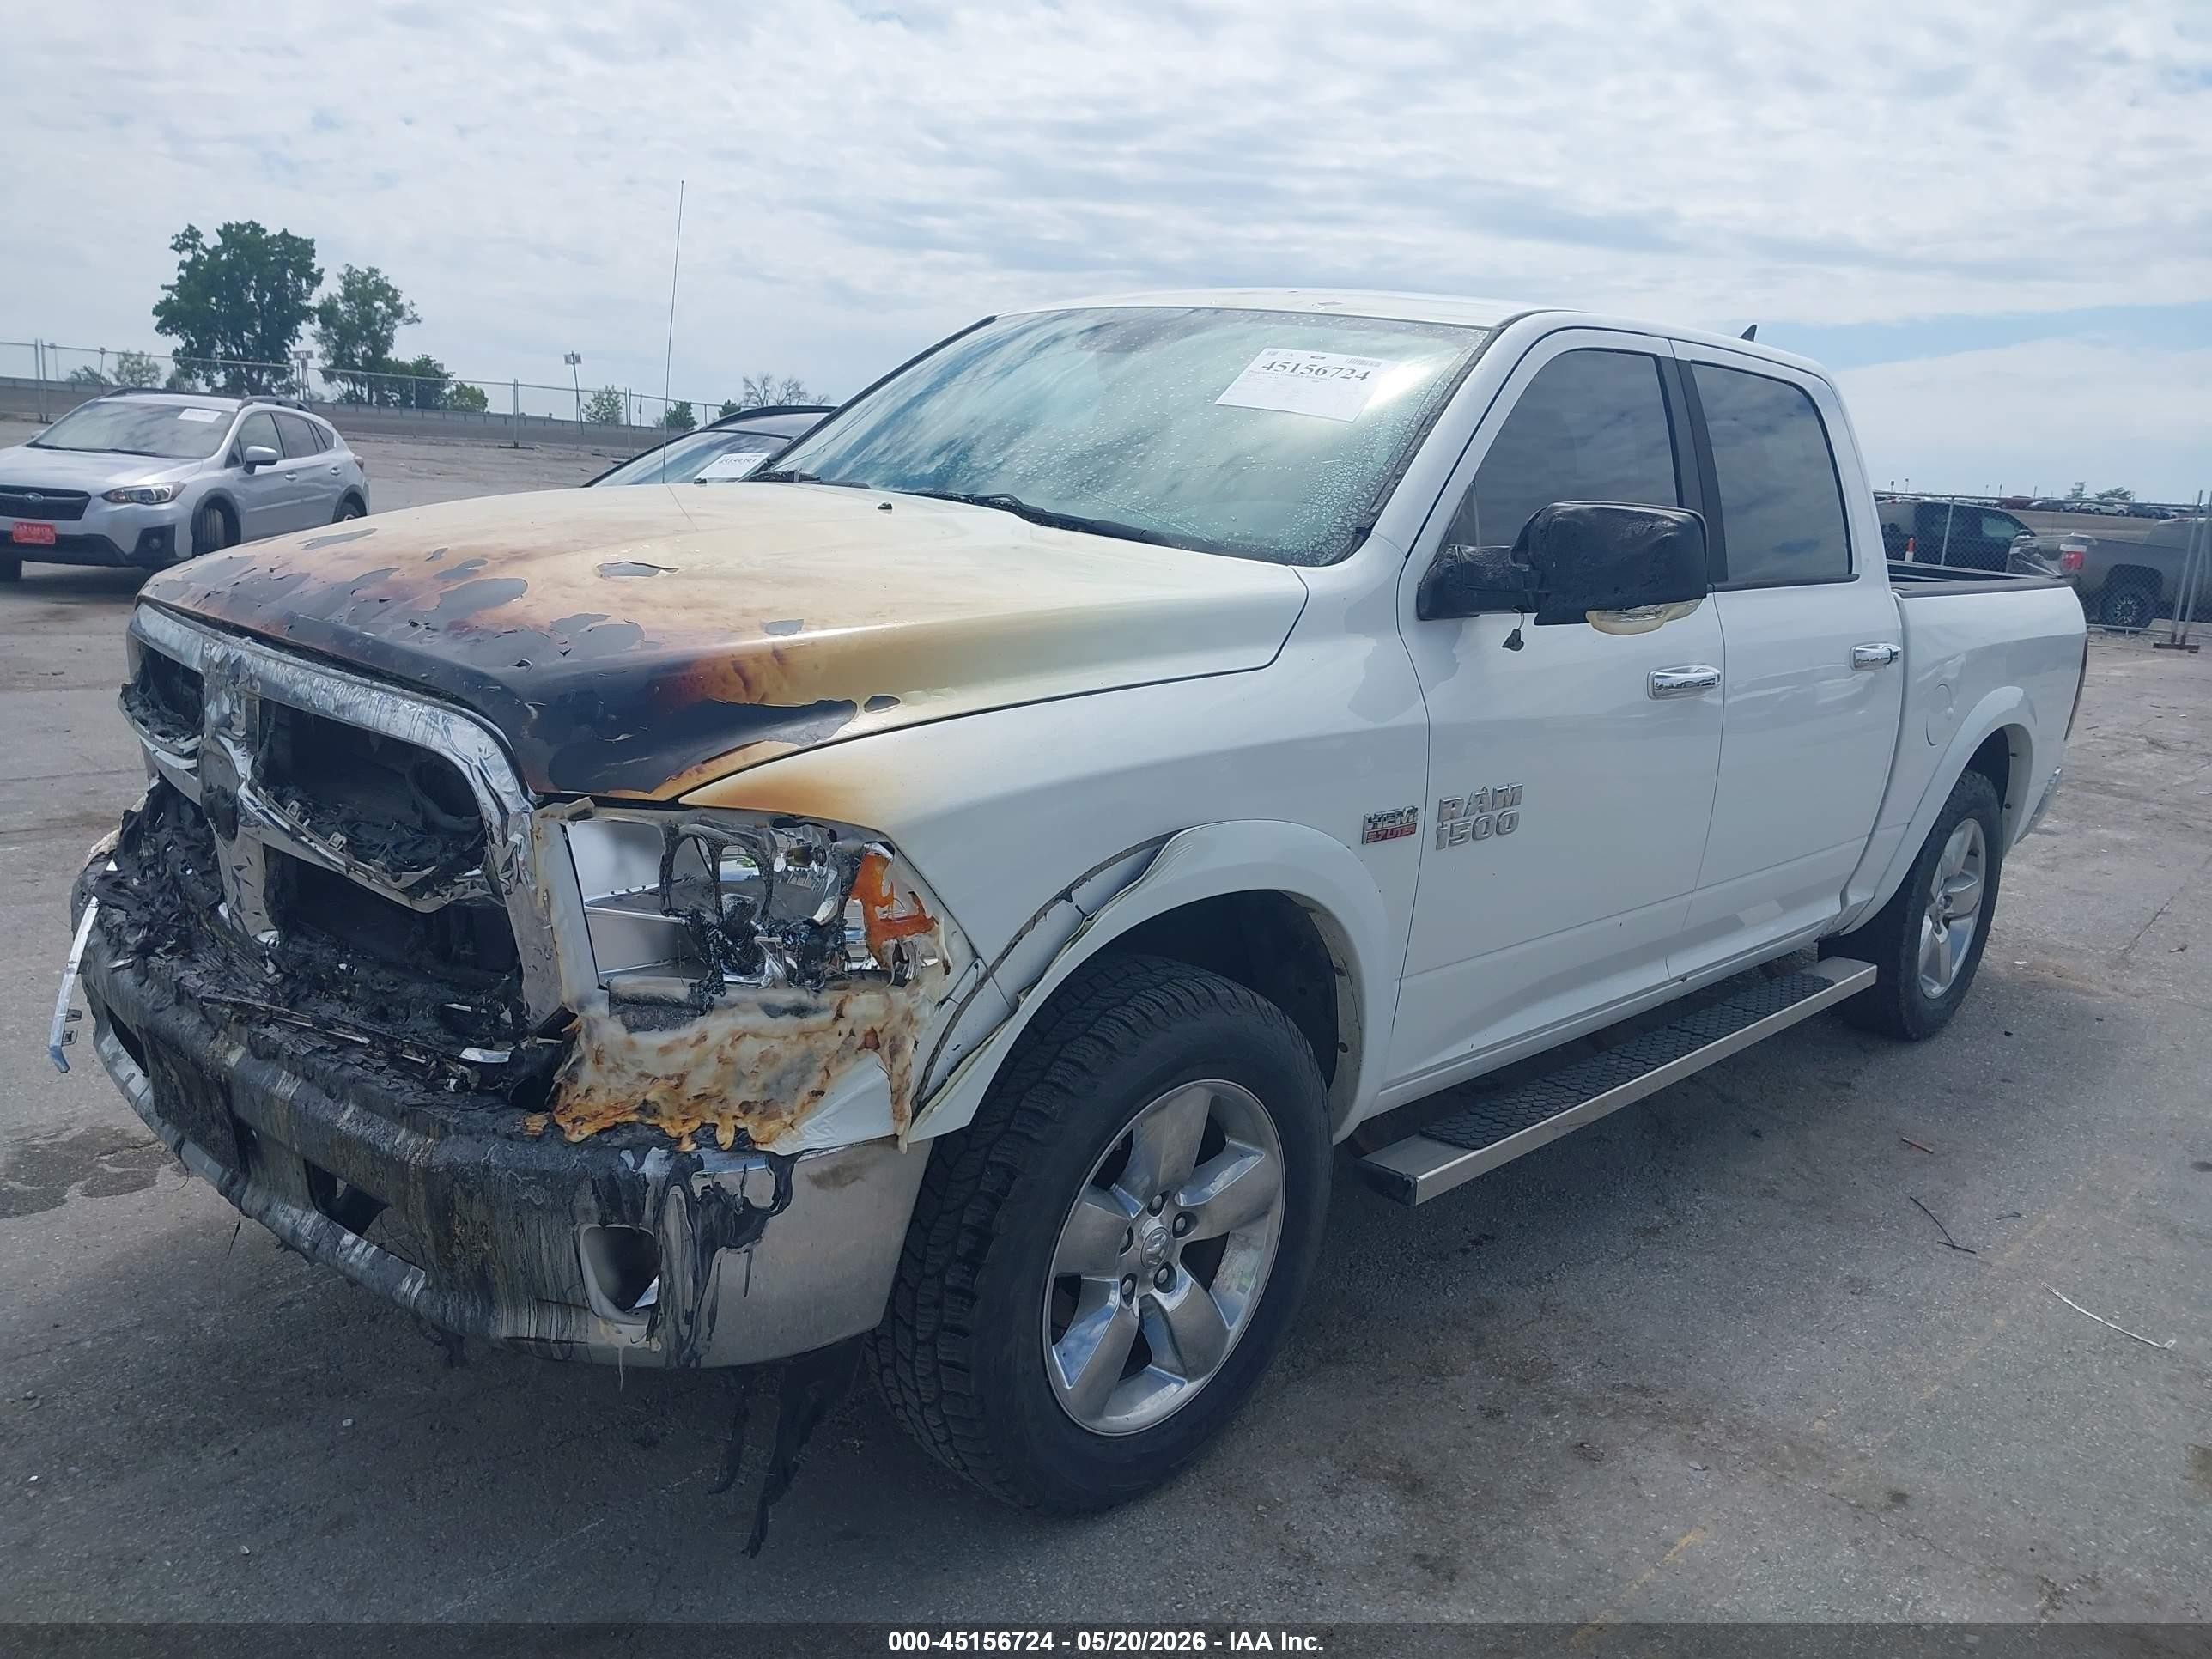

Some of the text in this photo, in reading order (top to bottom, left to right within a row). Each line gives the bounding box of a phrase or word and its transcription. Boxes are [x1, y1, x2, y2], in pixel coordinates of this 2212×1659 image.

[1261, 361, 1372, 381] 45156724
[1437, 782, 1523, 823] RAM
[1363, 805, 1418, 831] HEMI
[1436, 810, 1520, 850] 1500
[1386, 824, 1416, 839] LITER
